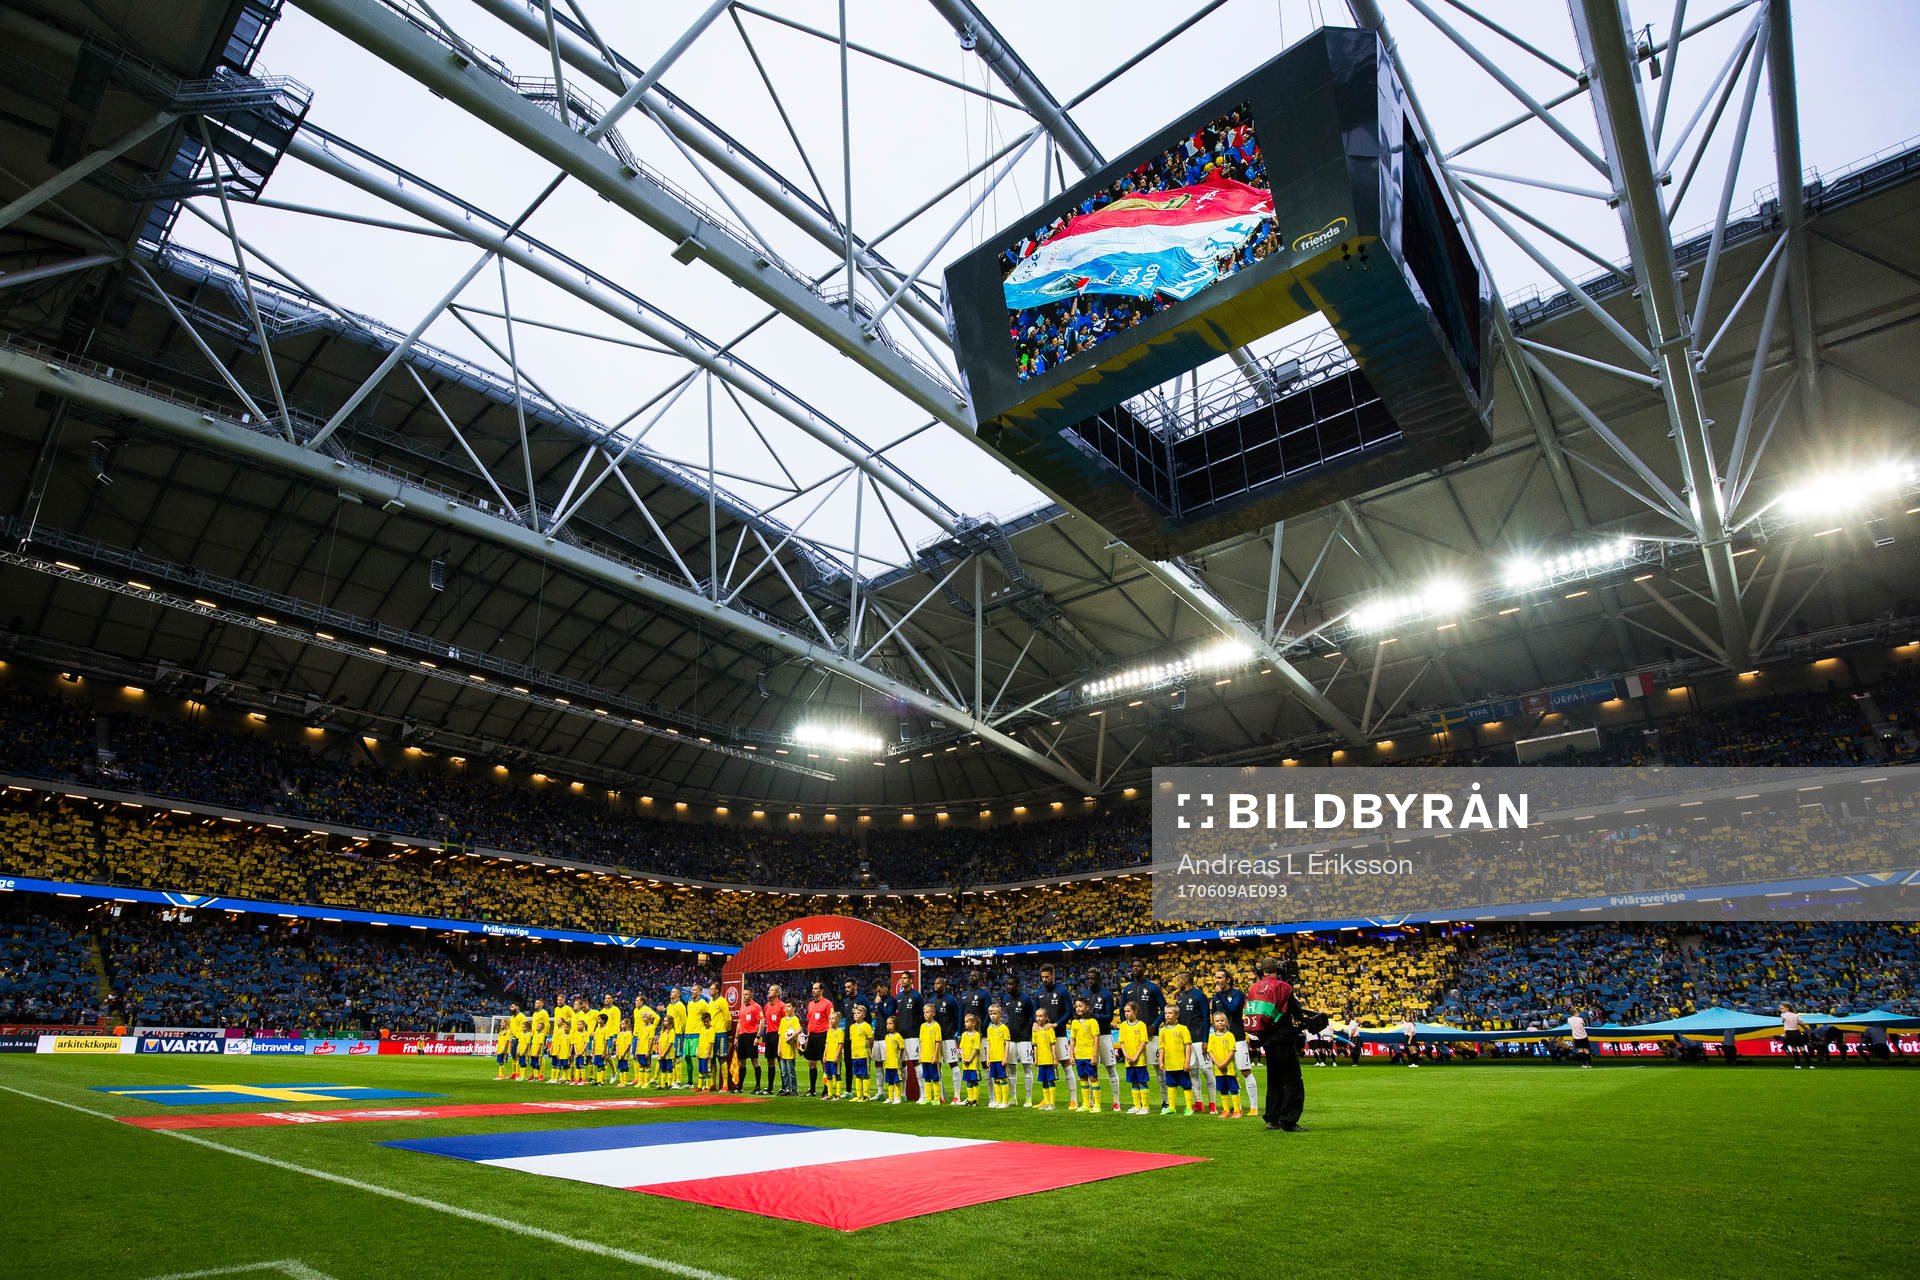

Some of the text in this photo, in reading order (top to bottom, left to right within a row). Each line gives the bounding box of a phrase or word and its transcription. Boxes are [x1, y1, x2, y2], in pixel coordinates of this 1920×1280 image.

[1300, 227, 1340, 250] friends
[1469, 708, 1489, 718] FIFA
[807, 931, 841, 942] EUROPEAN
[803, 940, 845, 954] QUALIFIERS
[57, 1038, 118, 1049] arkitektkopia
[161, 1040, 219, 1052] VARTA
[252, 1042, 305, 1052] latravel.se
[402, 1043, 433, 1053] Fraåt
[434, 1043, 446, 1053] för
[447, 1043, 473, 1053] svensk
